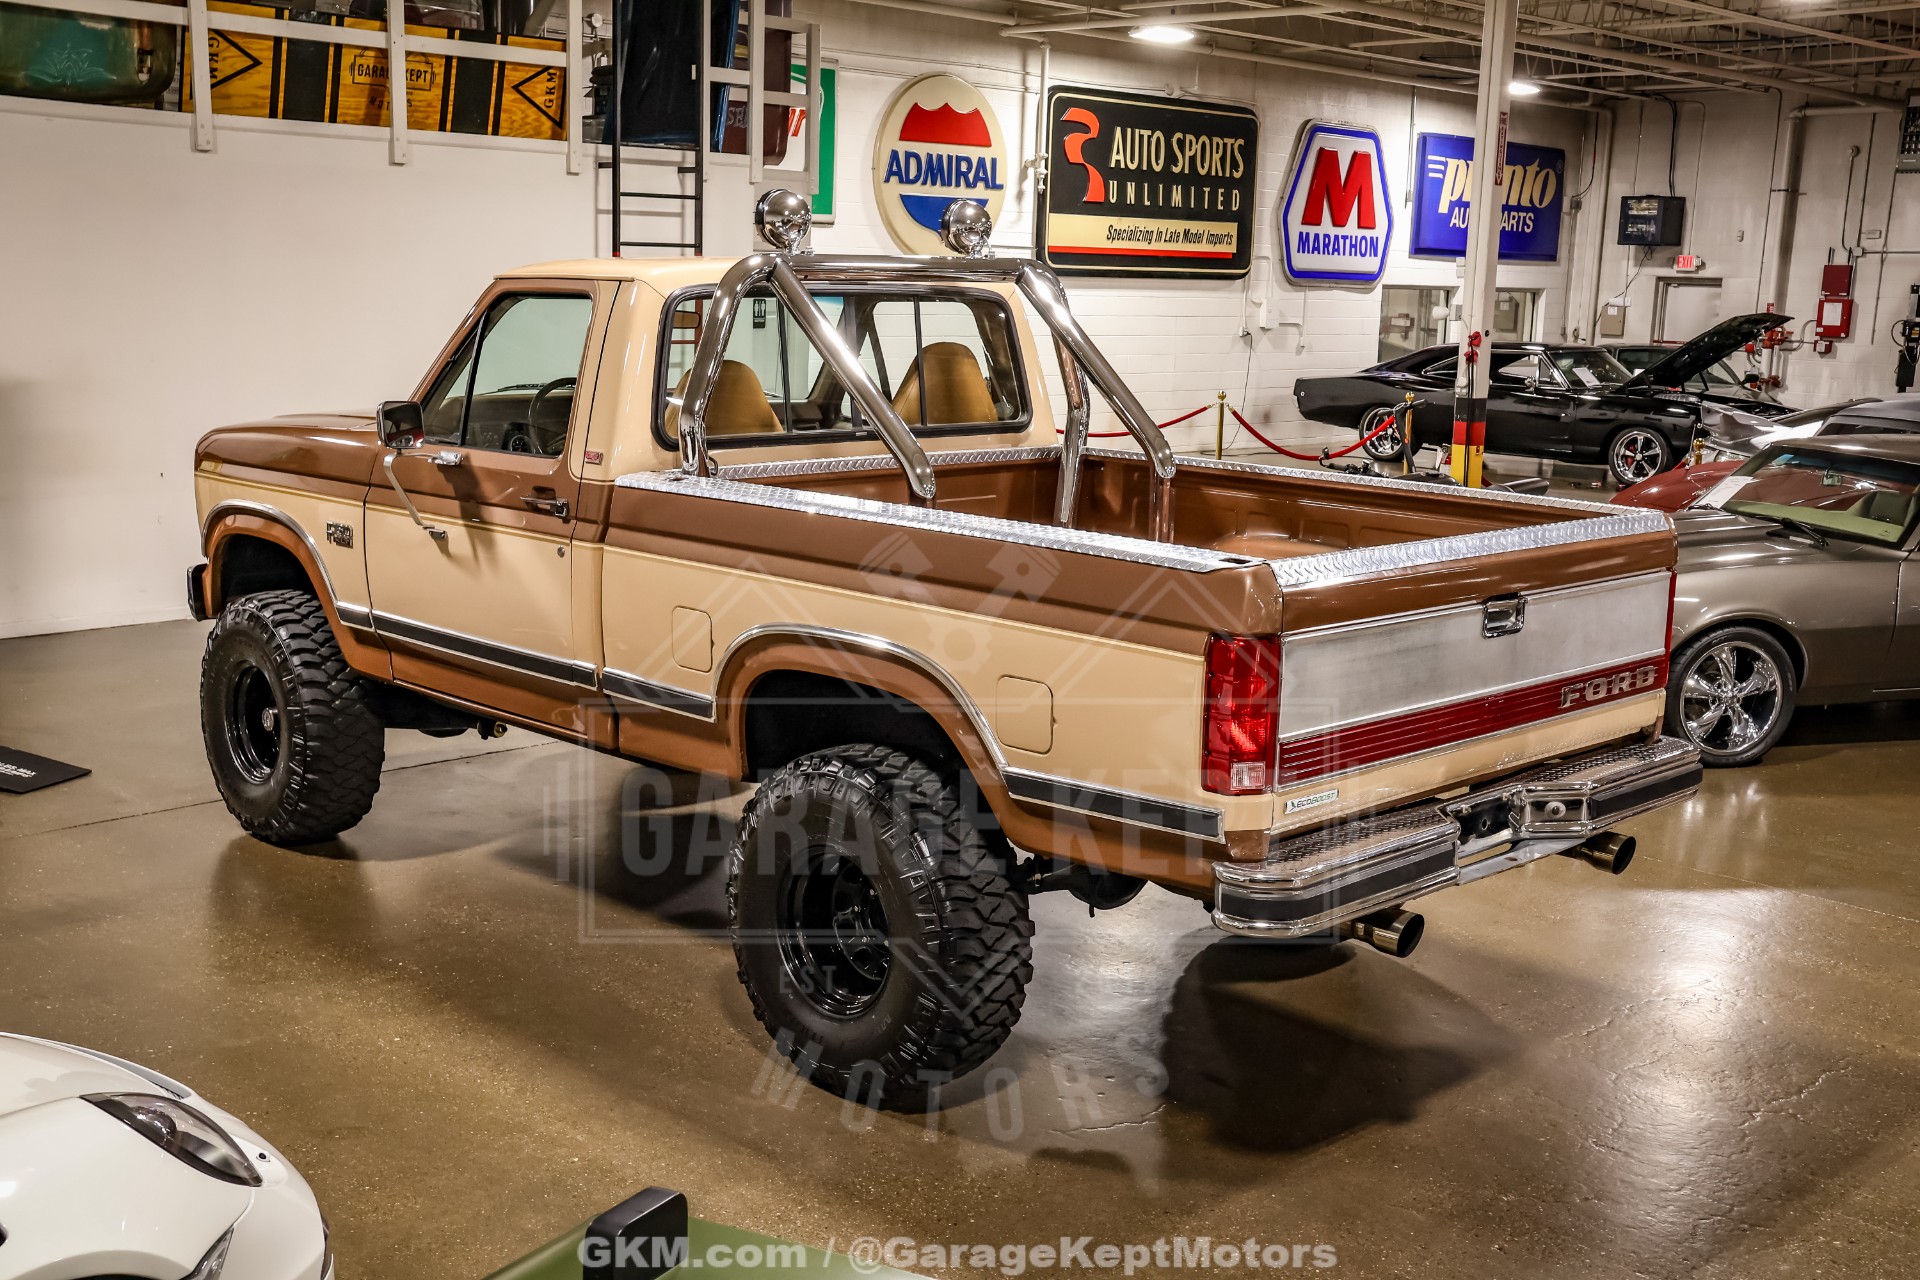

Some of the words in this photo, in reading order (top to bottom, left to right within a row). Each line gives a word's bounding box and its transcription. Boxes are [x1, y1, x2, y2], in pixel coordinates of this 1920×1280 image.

[543, 71, 558, 109] GKM
[884, 149, 1004, 191] ADMIRAL
[1109, 126, 1166, 173] AUTO
[1170, 131, 1245, 179] SPORTS
[1108, 180, 1241, 212] UNLIMITED
[1301, 147, 1376, 229] M
[1438, 157, 1557, 213] prnto
[1106, 224, 1154, 245] Specializing
[1164, 228, 1181, 244] Late
[1182, 228, 1204, 245] Model
[1205, 231, 1233, 247] Imports
[1500, 210, 1535, 234] ARTS
[1297, 231, 1379, 258] MARATHON
[1677, 255, 1694, 269] EXIT
[1558, 665, 1658, 709] FORD
